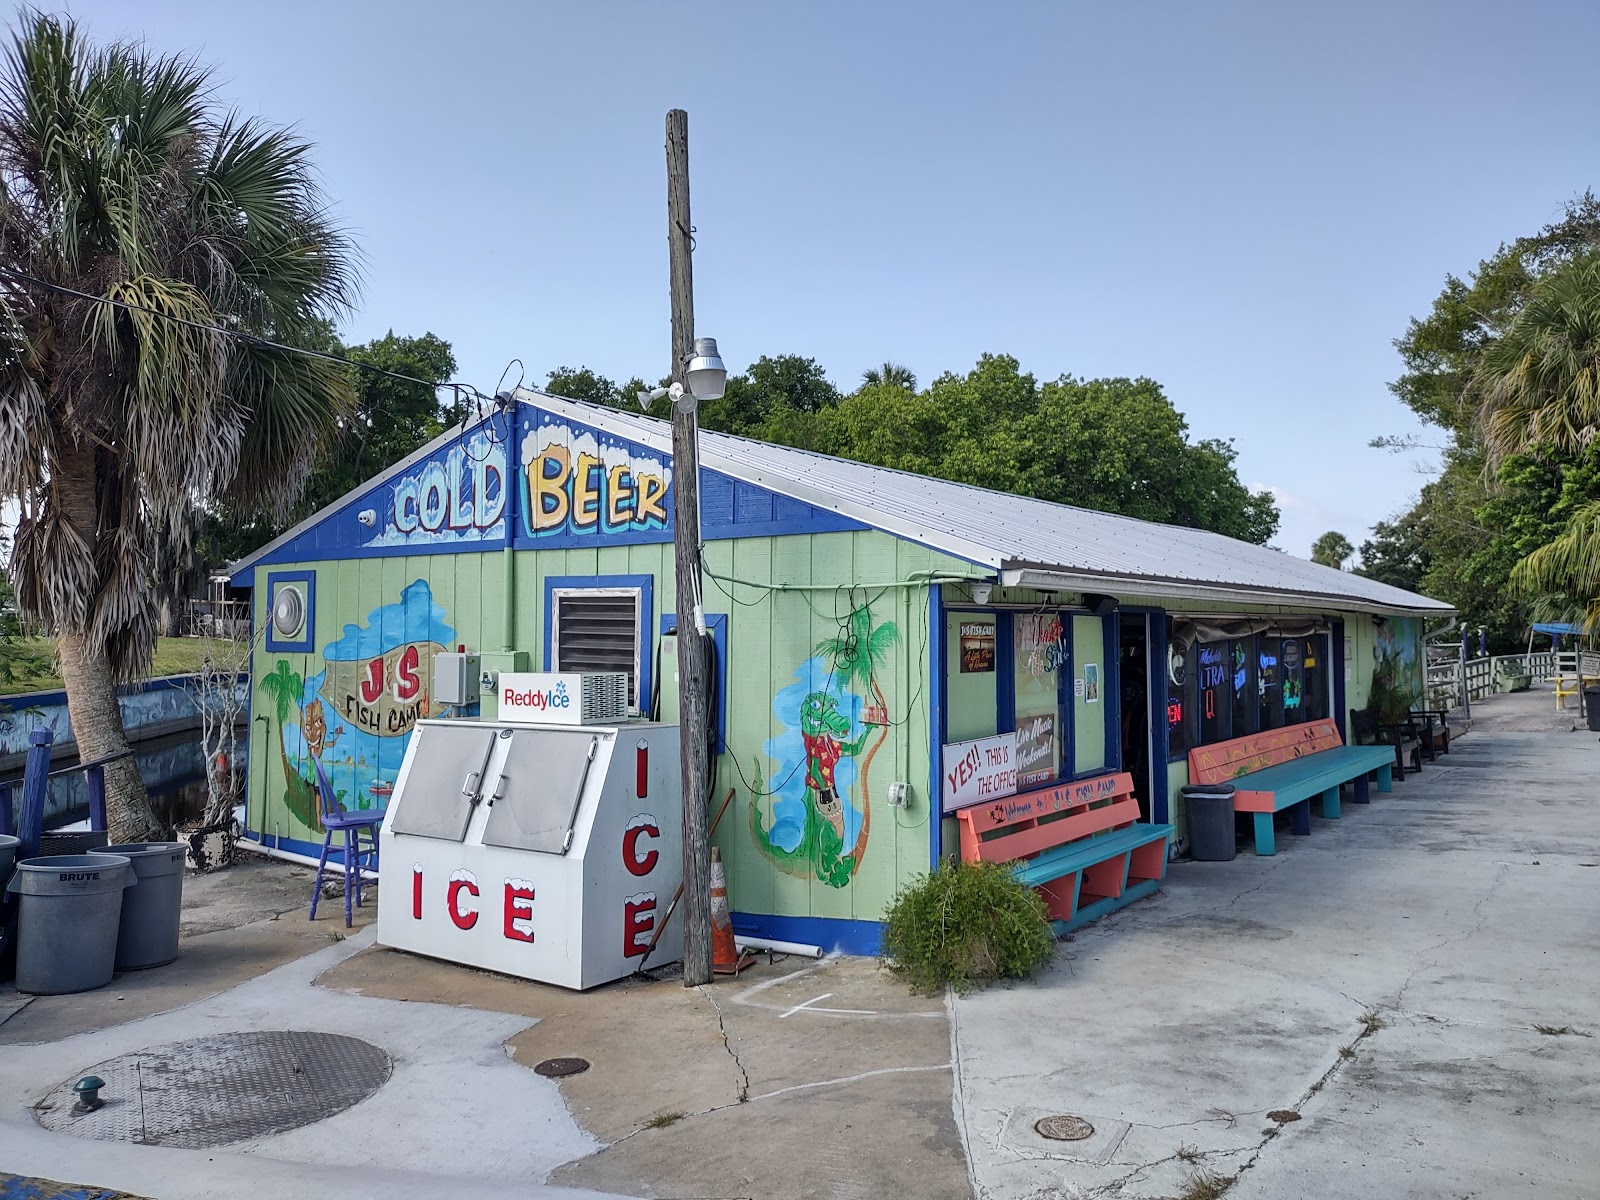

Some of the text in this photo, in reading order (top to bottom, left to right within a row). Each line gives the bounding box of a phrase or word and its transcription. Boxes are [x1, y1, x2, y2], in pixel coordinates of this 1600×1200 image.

[393, 430, 670, 537] COLD BEER
[1200, 664, 1225, 690] LTRA
[346, 694, 423, 732] FISH CAMP
[1016, 717, 1052, 750] Live Music
[947, 744, 982, 794] YES!!
[985, 745, 1009, 768] THIS IS
[977, 768, 1016, 796] THE OFFICE
[622, 738, 660, 958] ICE
[59, 872, 101, 882] BRUTE
[412, 862, 535, 943] ICE
